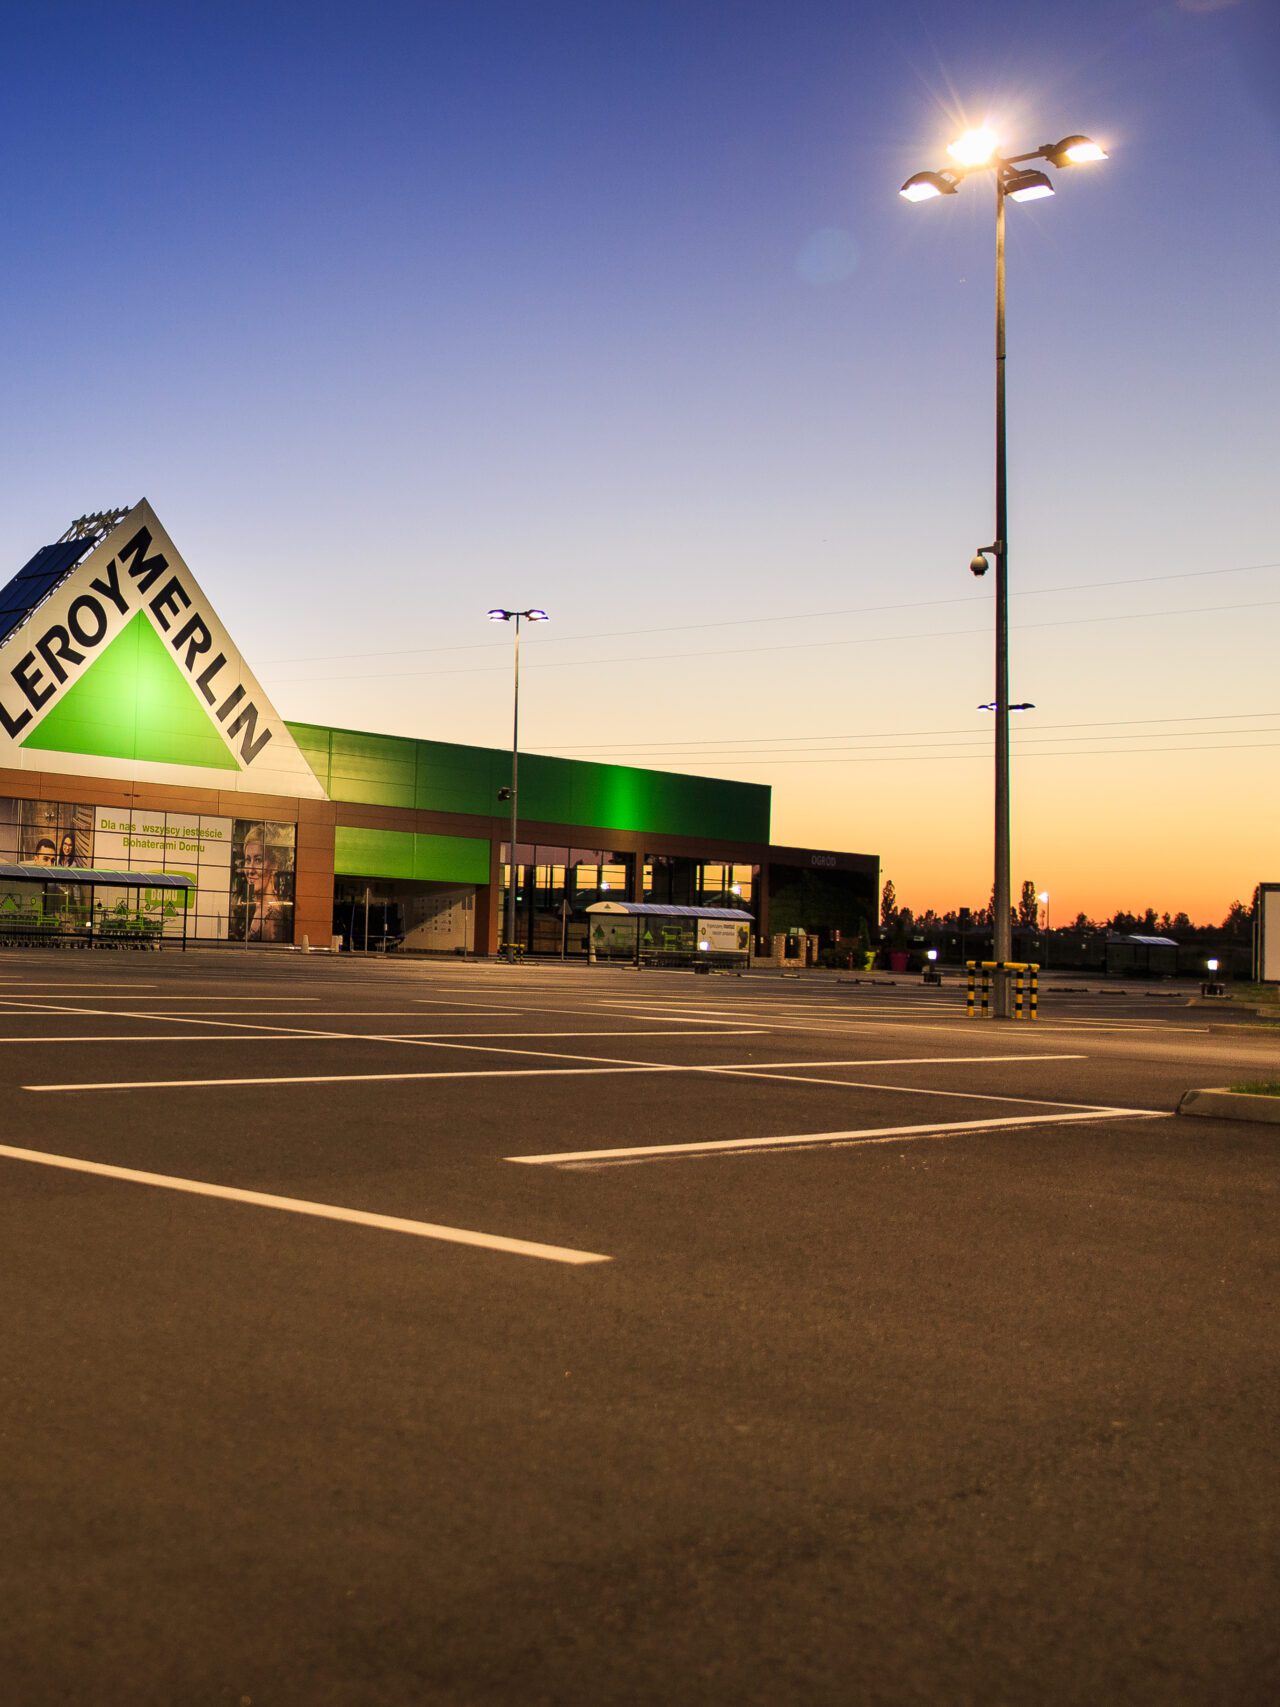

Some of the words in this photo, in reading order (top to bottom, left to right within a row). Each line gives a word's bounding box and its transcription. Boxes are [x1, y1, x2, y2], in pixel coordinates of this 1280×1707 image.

[117, 525, 273, 766] MERLIN
[100, 819, 116, 830] Dla
[119, 823, 136, 832] nas
[142, 825, 181, 837] wszyscy
[182, 826, 223, 839] jesteście
[122, 837, 177, 850] Bohaterami
[179, 841, 205, 853] Domu
[151, 888, 178, 901] DOMU
